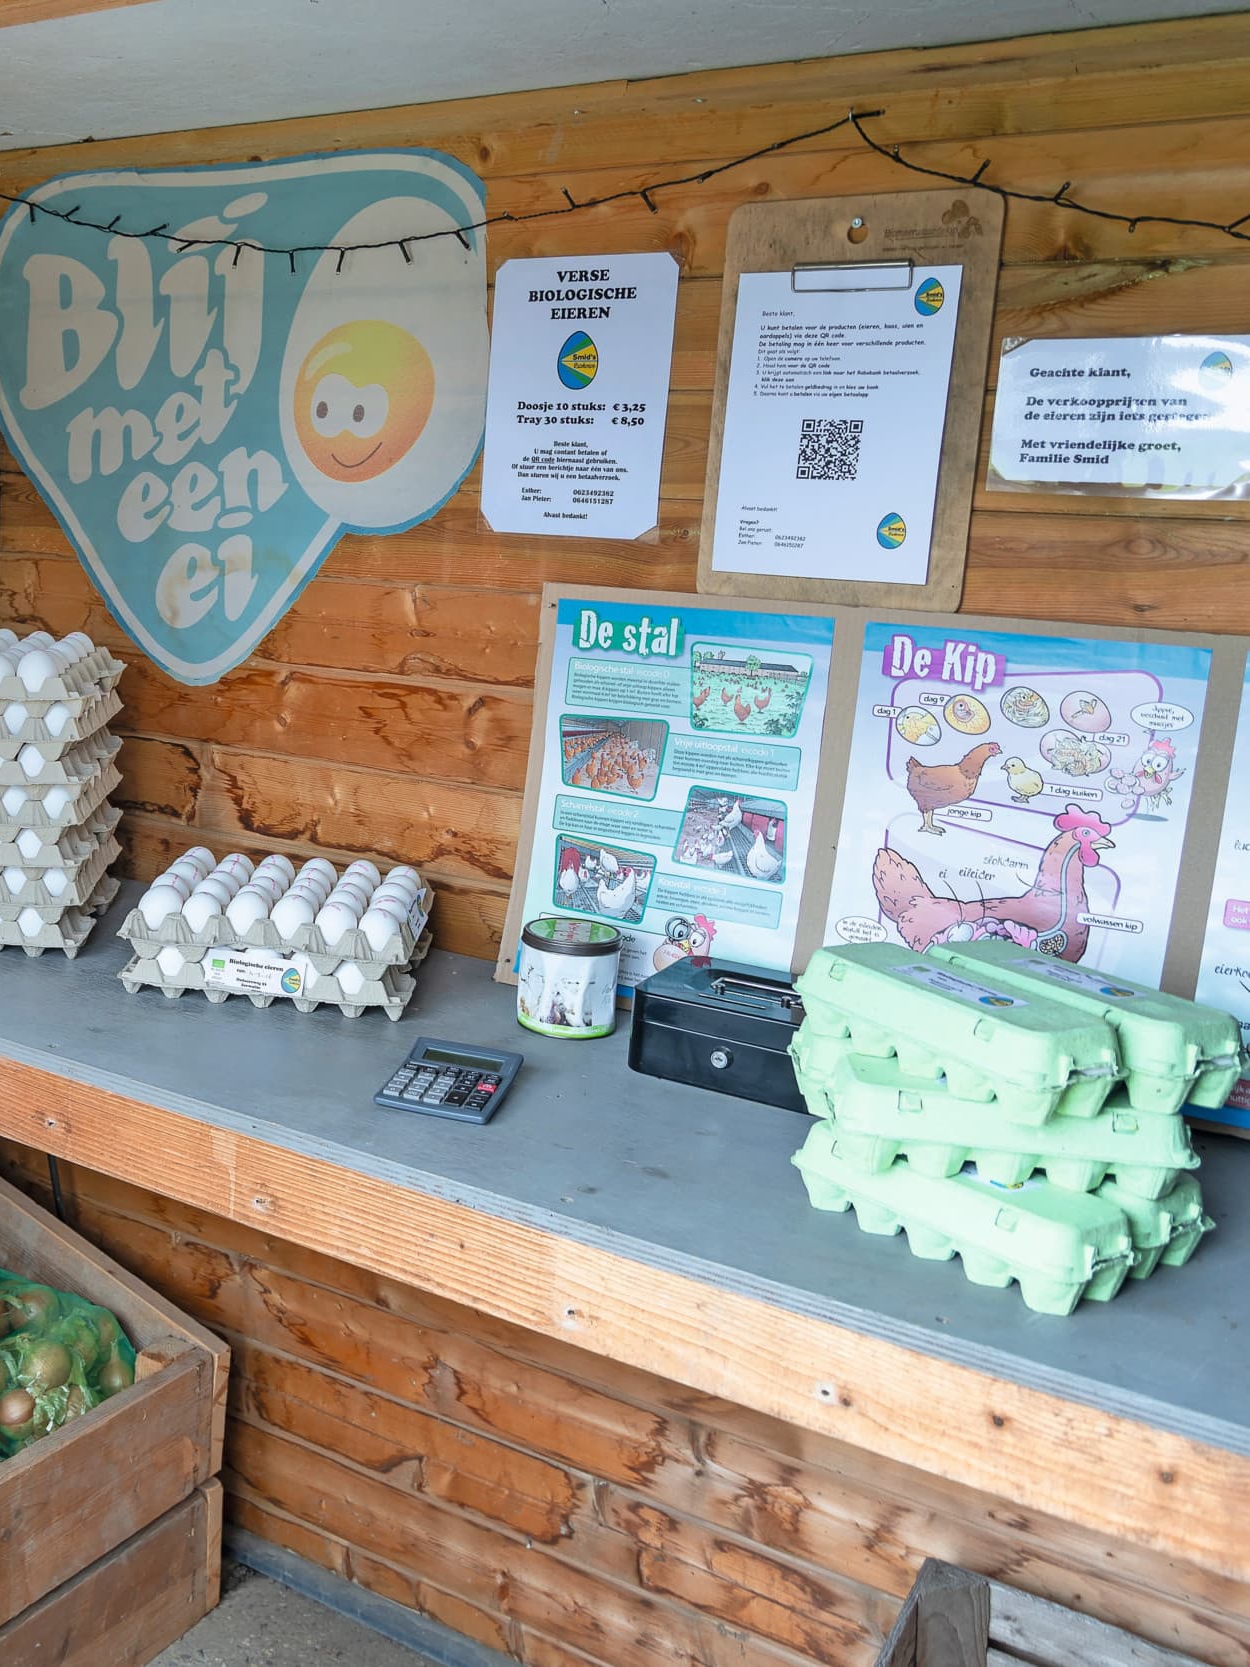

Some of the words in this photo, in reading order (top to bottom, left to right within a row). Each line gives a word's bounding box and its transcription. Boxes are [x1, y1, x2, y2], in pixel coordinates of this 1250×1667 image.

[557, 269, 610, 282] VERSE
[19, 192, 268, 410] Blij
[529, 287, 637, 302] BIOLOGISCHE
[551, 307, 611, 319] EIEREN
[1030, 368, 1085, 378] Geachte
[1088, 367, 1131, 379] klant,
[518, 401, 553, 412] Doosje
[572, 402, 606, 411] stuks:
[622, 403, 646, 412] 3,25
[1026, 396, 1044, 406] De
[1047, 396, 1157, 409] verkoopprijzen
[1161, 398, 1187, 406] van
[66, 349, 240, 484] met
[517, 415, 543, 425] Tray
[560, 416, 594, 424] stuks:
[620, 417, 644, 426] 8,50
[1024, 412, 1040, 421] de
[1043, 412, 1086, 421] eieren
[1088, 412, 1116, 423] zijn
[1119, 412, 1145, 421] iets
[1021, 440, 1046, 449] Met
[1050, 439, 1135, 451] vriendelijke
[1138, 441, 1181, 453] groet,
[1019, 454, 1070, 464] Familie
[1073, 454, 1109, 464] Smid
[117, 446, 288, 542] een
[155, 511, 258, 628] ei
[579, 610, 613, 650] De
[622, 617, 679, 656] stal
[891, 635, 932, 677] De
[941, 641, 997, 690] Kip
[924, 696, 937, 704] dag
[877, 708, 891, 717] dag
[1098, 733, 1114, 744] dag
[1116, 734, 1125, 743] 21
[1055, 786, 1070, 797] dag
[1072, 788, 1098, 799] kuiken
[947, 807, 966, 817] jonge
[968, 810, 982, 819] kip
[938, 868, 948, 879] ei
[958, 867, 996, 882] eileider
[1082, 915, 1121, 928] volwassen
[1124, 920, 1137, 932] kip
[230, 958, 264, 969] Biologische
[265, 964, 284, 972] eieren
